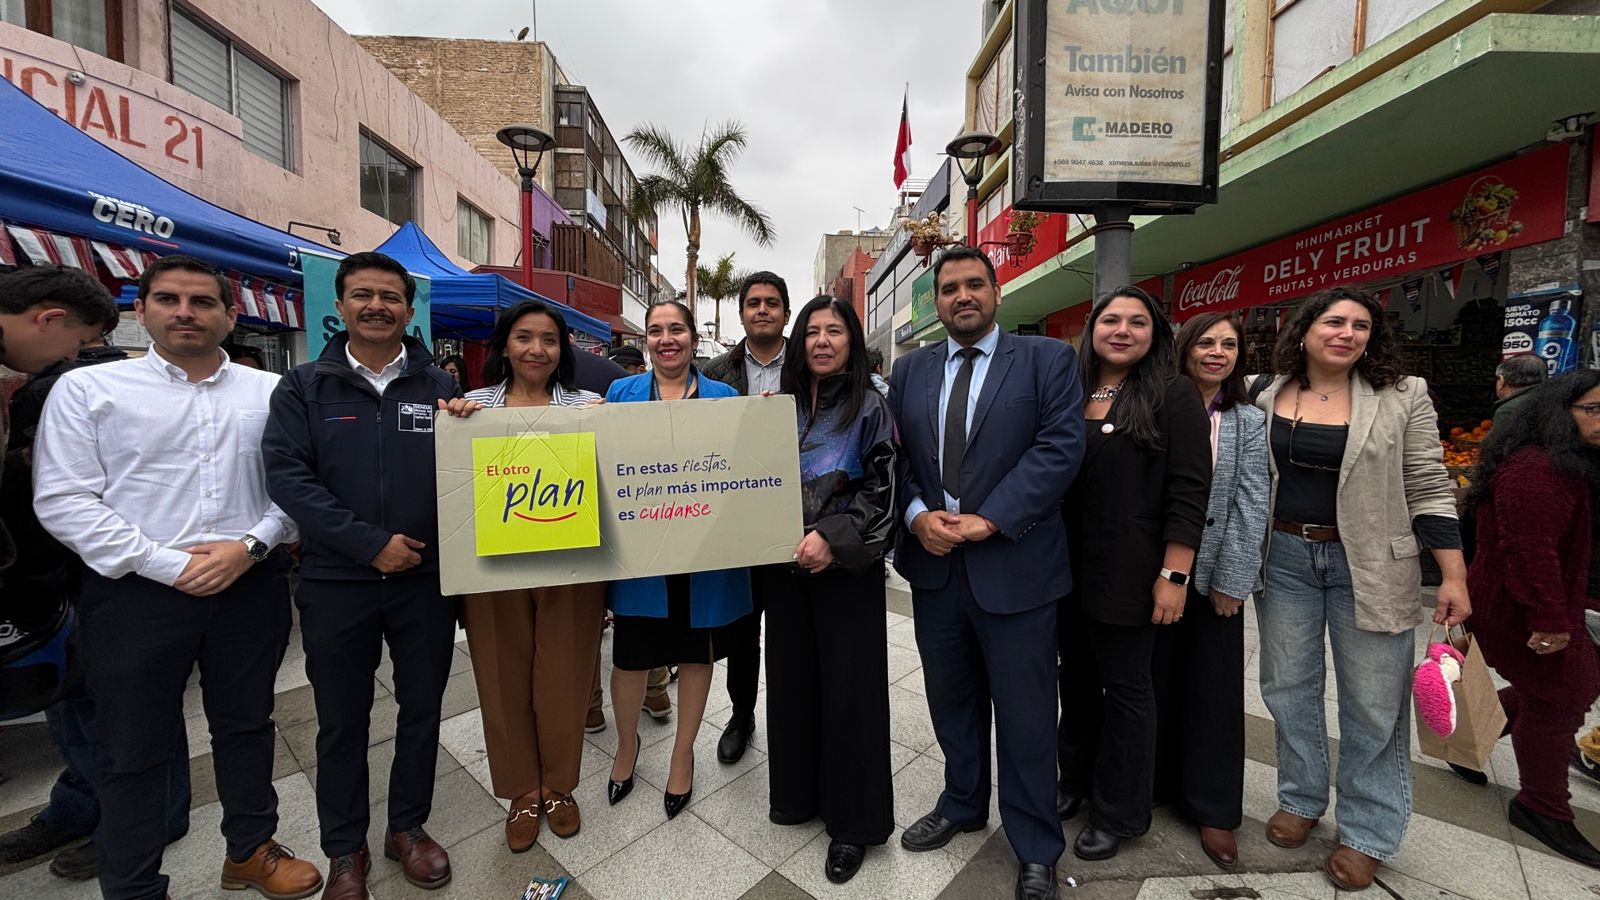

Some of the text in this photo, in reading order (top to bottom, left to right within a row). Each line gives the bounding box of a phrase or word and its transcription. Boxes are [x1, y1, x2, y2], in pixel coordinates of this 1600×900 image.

[1065, 45, 1186, 74] También
[1065, 84, 1184, 99] Avisa con Nosotros
[164, 115, 203, 170] 21
[1105, 122, 1173, 134] MADERO
[93, 198, 175, 239] CERO
[1295, 214, 1384, 250] MINIMARKET
[1263, 218, 1431, 283] DELY FRUIT
[1179, 264, 1246, 311] Coca-Cola
[1268, 251, 1417, 296] FRUTAS Y VERDURAS
[486, 465, 530, 476] El otro
[616, 463, 636, 476] En
[640, 462, 678, 475] estas
[502, 468, 584, 523] plan
[617, 476, 782, 500] el plan más importante
[618, 501, 712, 521] es cuidarse
